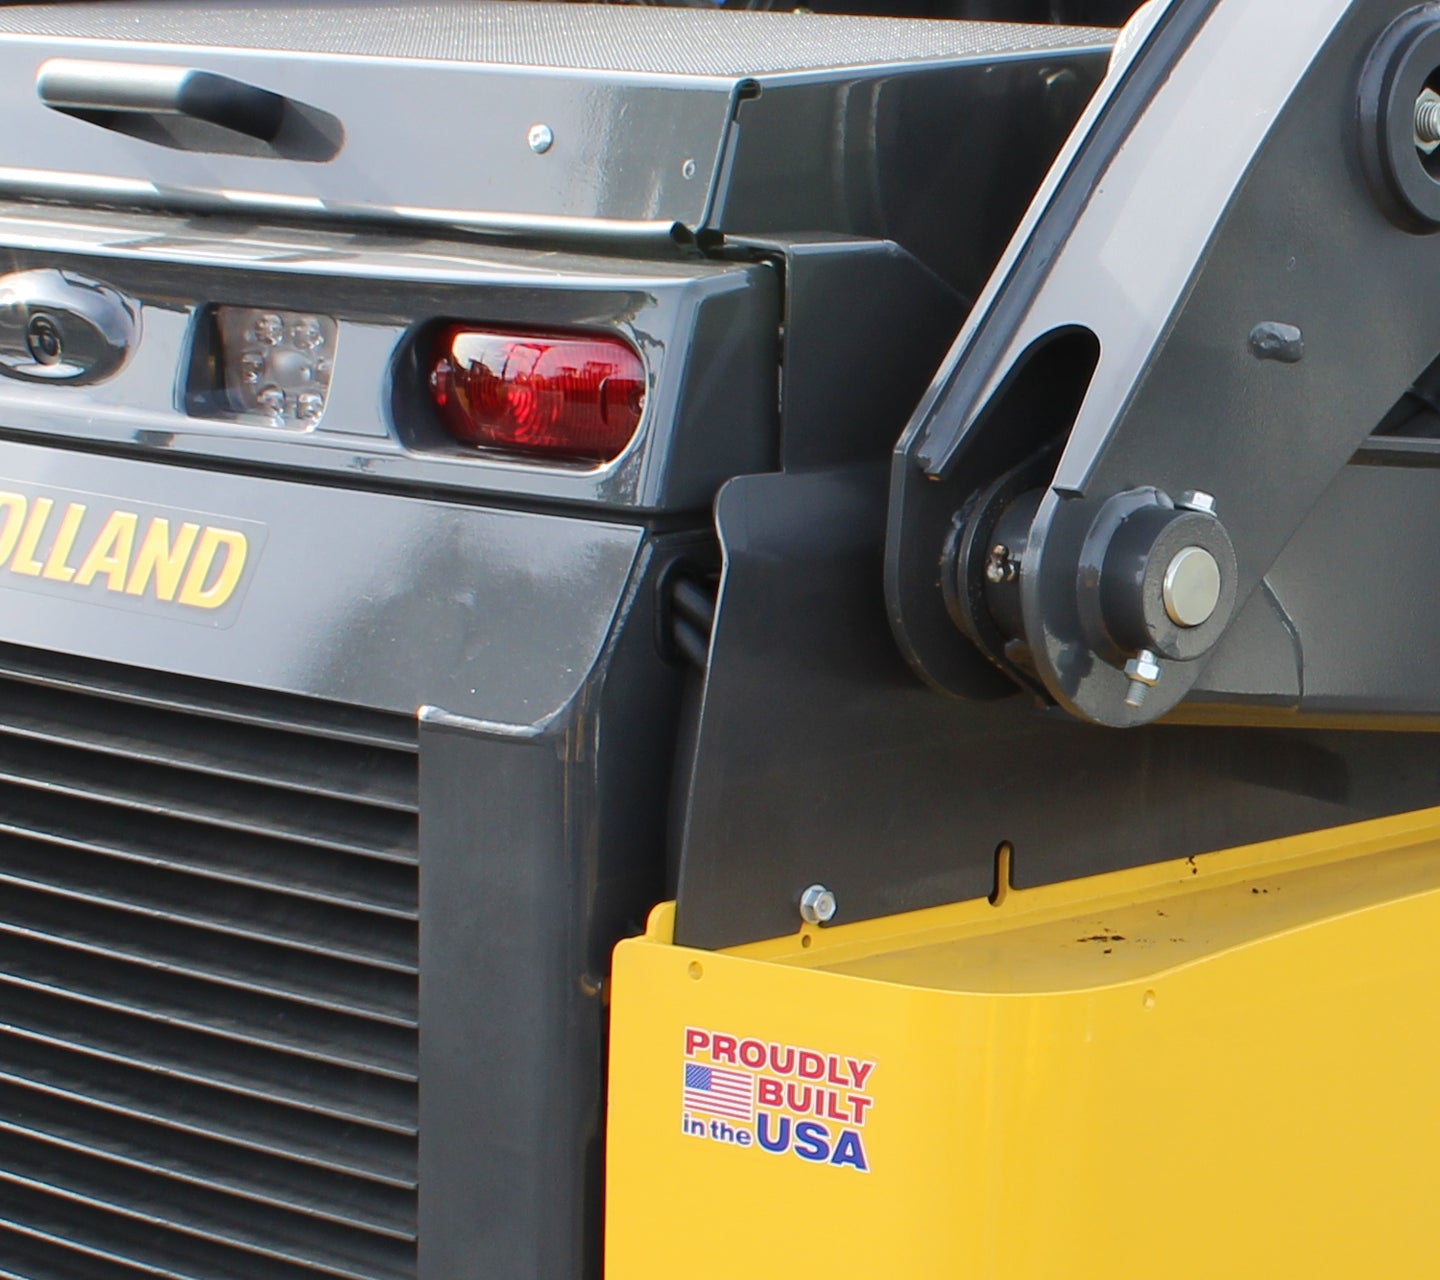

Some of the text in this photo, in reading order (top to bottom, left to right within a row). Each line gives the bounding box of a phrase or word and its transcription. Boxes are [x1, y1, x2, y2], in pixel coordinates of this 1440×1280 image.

[685, 1028, 873, 1090] PROUDLY
[758, 1077, 872, 1125] BUILT
[683, 1111, 868, 1171] in the USA
